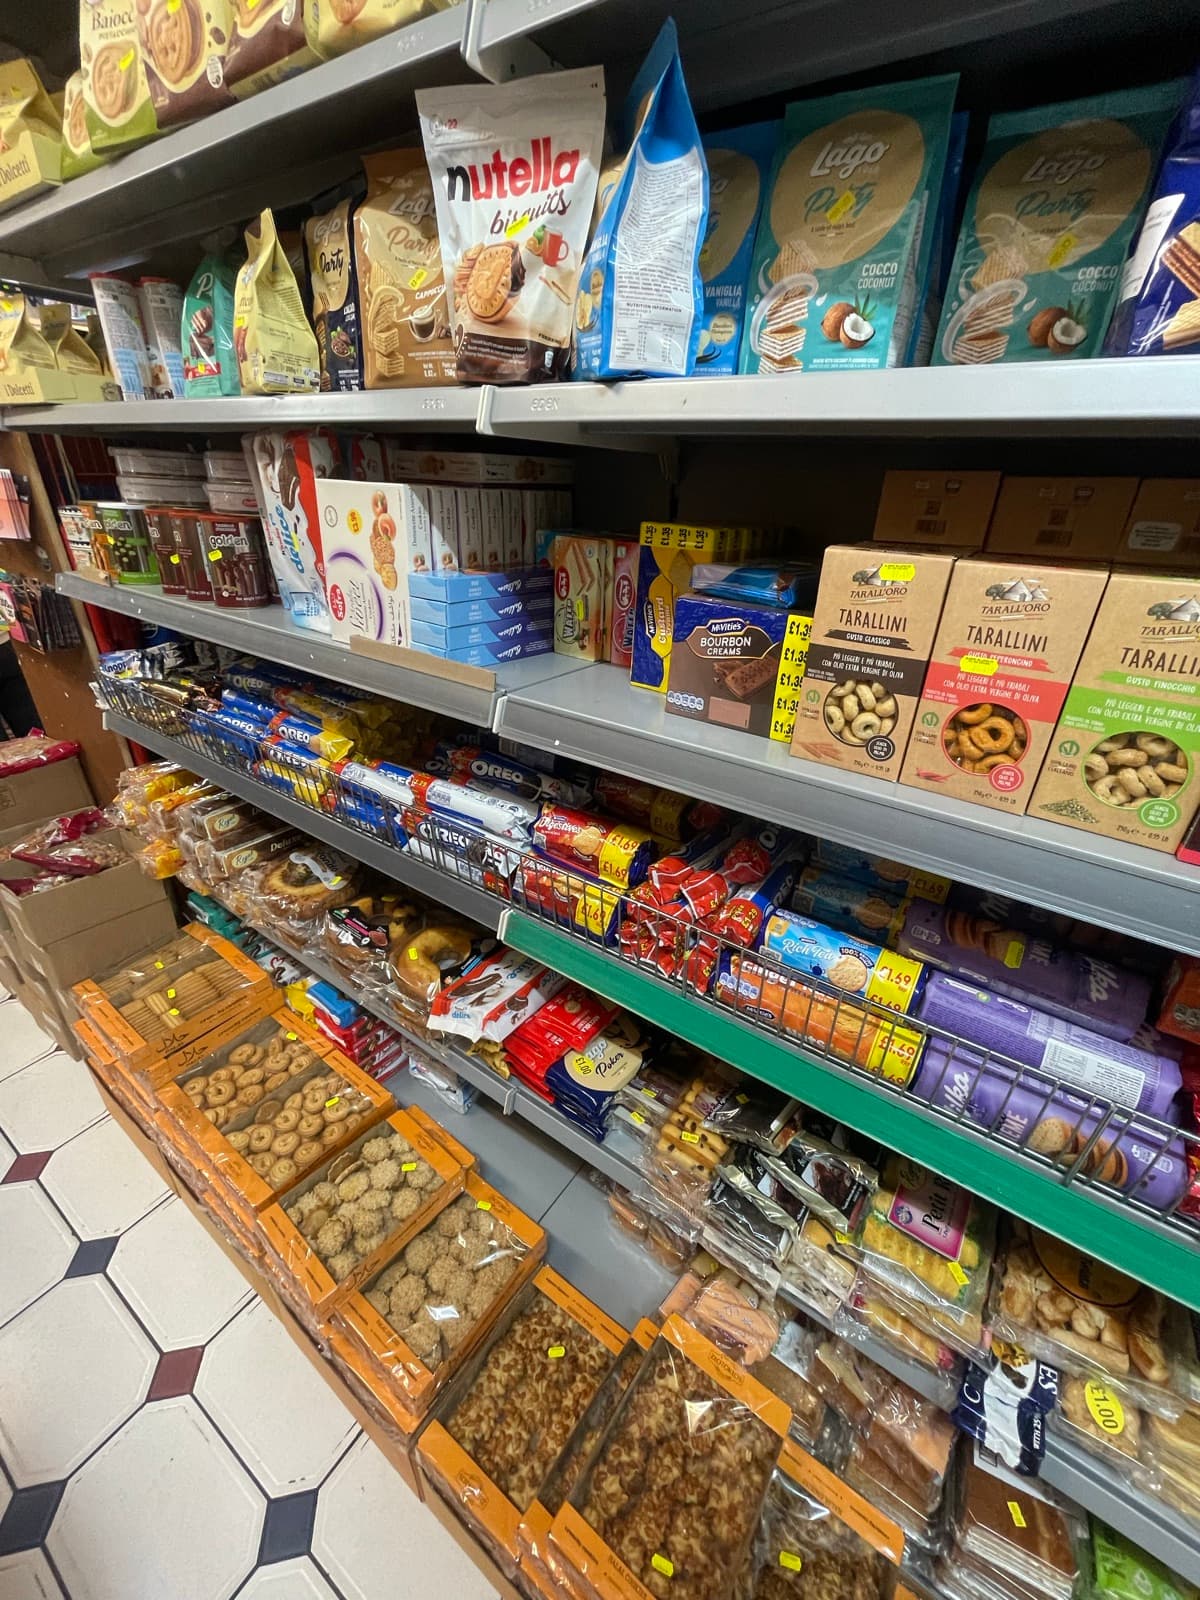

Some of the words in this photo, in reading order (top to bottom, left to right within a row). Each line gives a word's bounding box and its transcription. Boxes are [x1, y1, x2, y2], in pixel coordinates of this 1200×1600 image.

[1, 155, 31, 184] Dolcetti
[446, 136, 580, 202] nutella
[809, 141, 891, 180] Lago
[1021, 153, 1107, 184] Lago
[804, 181, 878, 225] Pty
[861, 262, 898, 277] COCCO
[1078, 266, 1119, 280] COCCO
[858, 276, 896, 289] COCONUT
[1072, 279, 1114, 293] COCONUT
[705, 286, 742, 299] VANIGLIA
[9, 381, 35, 397] Dolcetti
[209, 534, 250, 549] golden
[644, 525, 655, 545] £1.35
[660, 526, 671, 546] £1.35
[677, 527, 688, 547] £1.35
[694, 529, 705, 550] £1.35
[849, 586, 908, 599] TARALL'ORO
[336, 588, 344, 619] Sofra
[981, 603, 1051, 615] TARALL'ORO
[711, 621, 742, 632] McVitie's
[839, 608, 908, 633] TARALLINI
[700, 636, 752, 648] BOURBON
[846, 633, 865, 643] GUSTO
[865, 635, 891, 646] CLASSICO
[966, 625, 1049, 653] TARALLINI
[706, 647, 741, 656] CREAMS
[841, 653, 860, 662] LEGGERI
[832, 661, 845, 670] OLIO
[845, 662, 860, 672] EXTRA
[861, 664, 881, 675] VERGINE
[889, 670, 904, 679] OLIVA
[943, 680, 955, 688] CON
[955, 681, 969, 691] OLIO
[970, 684, 987, 695] EXTRA
[989, 687, 1013, 698] VERGINE
[1022, 694, 1040, 703] OLIVA
[1126, 675, 1151, 687] GUSTO
[1154, 679, 1196, 693] FINOCCHIO
[1118, 699, 1144, 712] LEGGERI
[1088, 705, 1102, 714] CON
[1103, 707, 1120, 719] OLIO
[1121, 710, 1142, 722] EXTRA
[1145, 715, 1174, 728] VERGINE
[278, 725, 311, 744] OREO
[470, 759, 524, 785] OREO
[538, 816, 581, 834] Digestives
[611, 834, 638, 851] £1.69
[603, 861, 628, 878] £1.69
[915, 877, 944, 894] £1.69
[581, 903, 606, 921] £1.69
[782, 938, 810, 956] Rich
[811, 944, 835, 962] Tea
[880, 965, 912, 985] £1.69
[586, 1040, 608, 1062] ago
[574, 1057, 593, 1076] £1.00
[595, 1051, 624, 1078] Poker
[921, 1191, 948, 1233] Petit
[1090, 1384, 1119, 1430] £1.00
